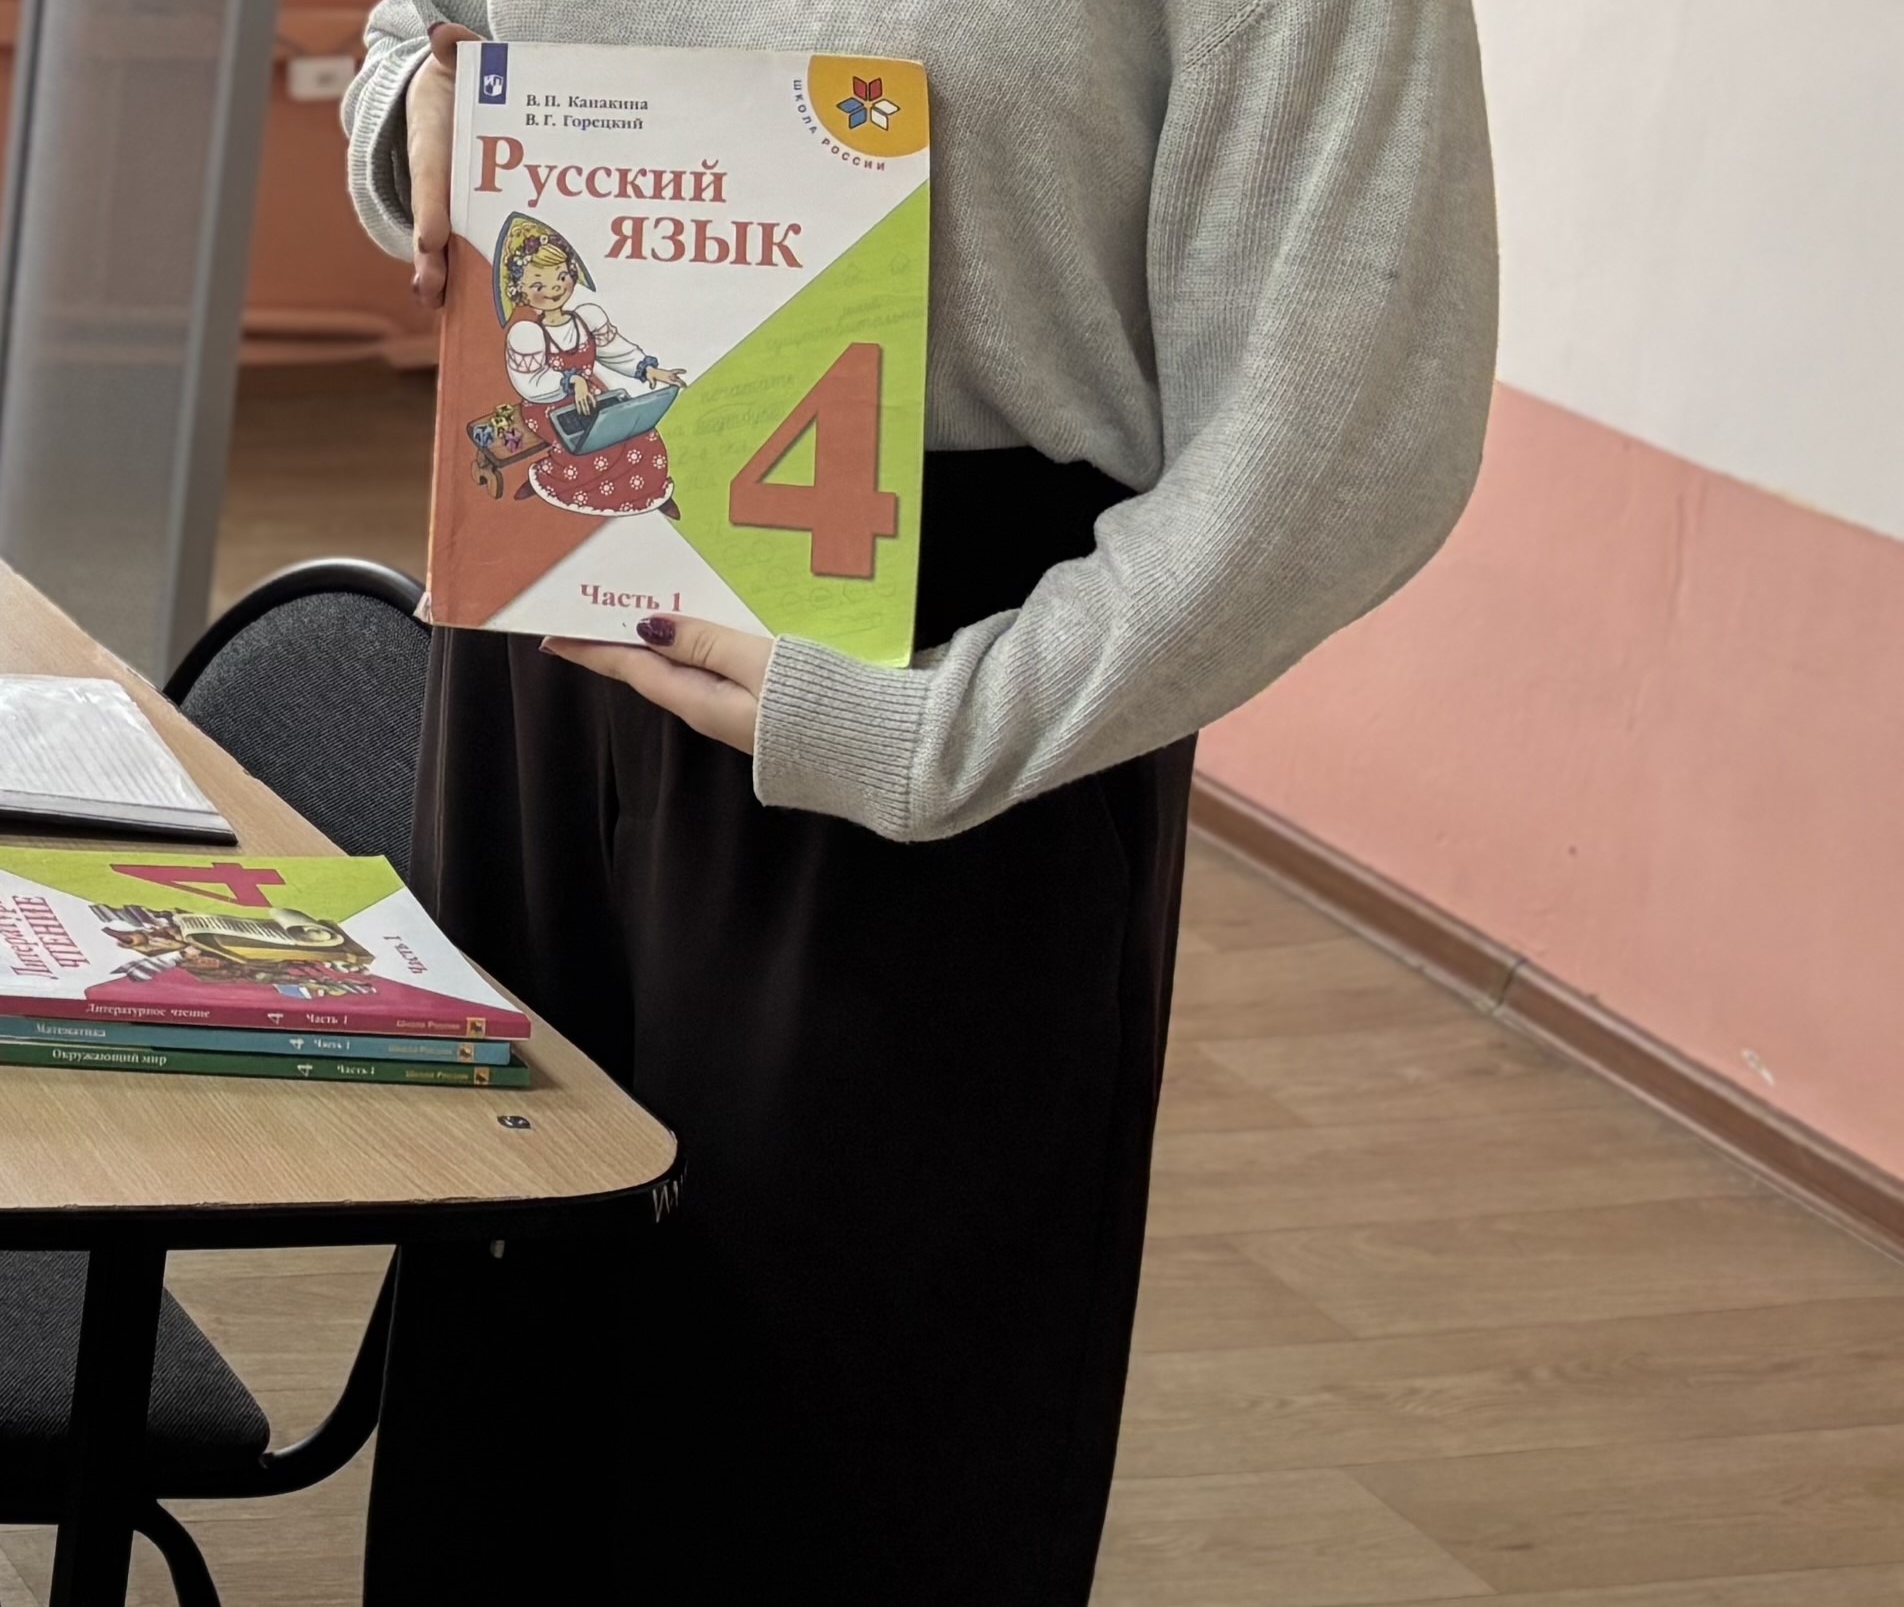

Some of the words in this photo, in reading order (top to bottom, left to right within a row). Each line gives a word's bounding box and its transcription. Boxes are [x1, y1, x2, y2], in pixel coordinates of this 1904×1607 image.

[567, 96, 649, 111] Канакина
[563, 115, 644, 131] Горецкий
[793, 79, 817, 134] ШКОЛА
[821, 138, 886, 171] РОССИИ
[474, 135, 728, 208] Русский
[604, 215, 804, 269] ЯЗЫК
[728, 342, 898, 581] 4
[580, 584, 660, 611] Часть
[672, 592, 682, 612] 1
[109, 862, 286, 907] 4
[86, 1003, 165, 1017] Литературное
[171, 1009, 210, 1018] чтение
[306, 1014, 338, 1024] Часть
[36, 1023, 106, 1037] Математика
[314, 1039, 342, 1049] Часть
[52, 1048, 139, 1063] Окружающий
[142, 1056, 167, 1066] мир
[337, 1065, 367, 1074] Часть
